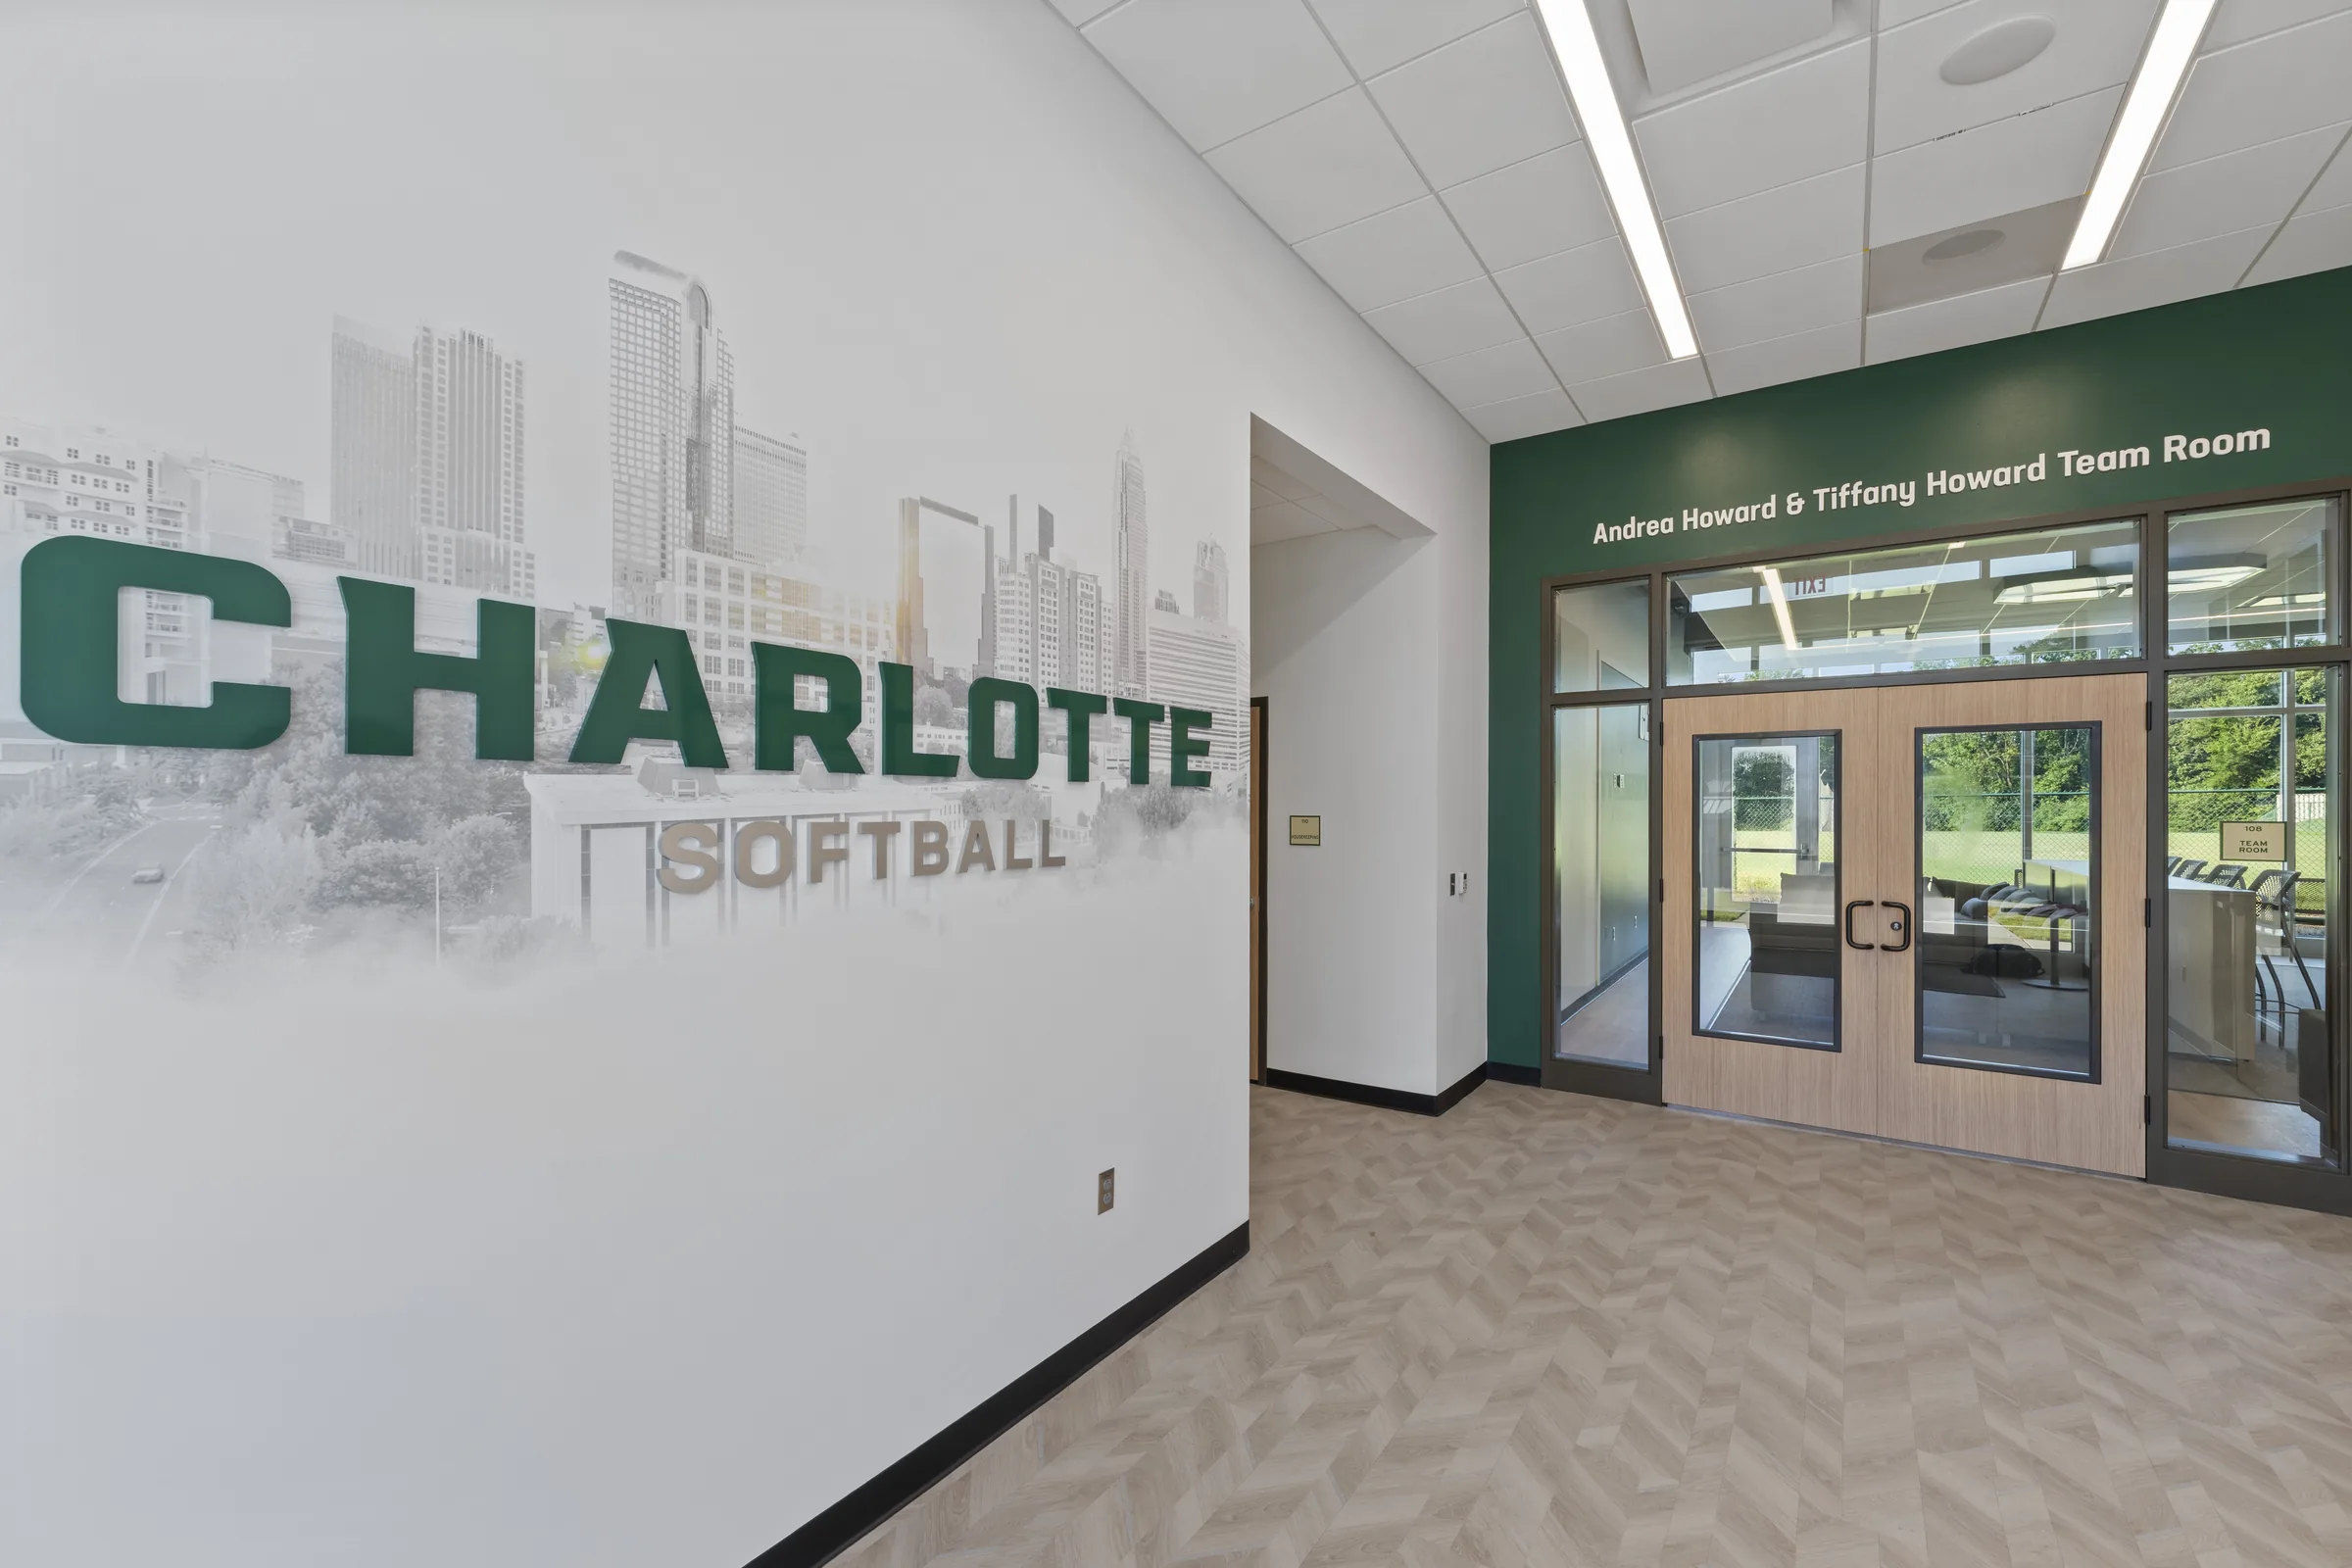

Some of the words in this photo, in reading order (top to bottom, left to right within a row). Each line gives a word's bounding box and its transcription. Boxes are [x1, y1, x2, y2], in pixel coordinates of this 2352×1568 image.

[1592, 516, 1674, 544] Andrea
[1683, 494, 1777, 531] Howard
[1786, 492, 1805, 515] &
[1813, 481, 1916, 512] Tiffany
[1927, 453, 2046, 496] Howard
[2057, 446, 2150, 476] Team
[2163, 427, 2271, 464] Room
[20, 534, 1213, 787] CHARLOTTE
[657, 819, 1066, 894] SOFTBALL
